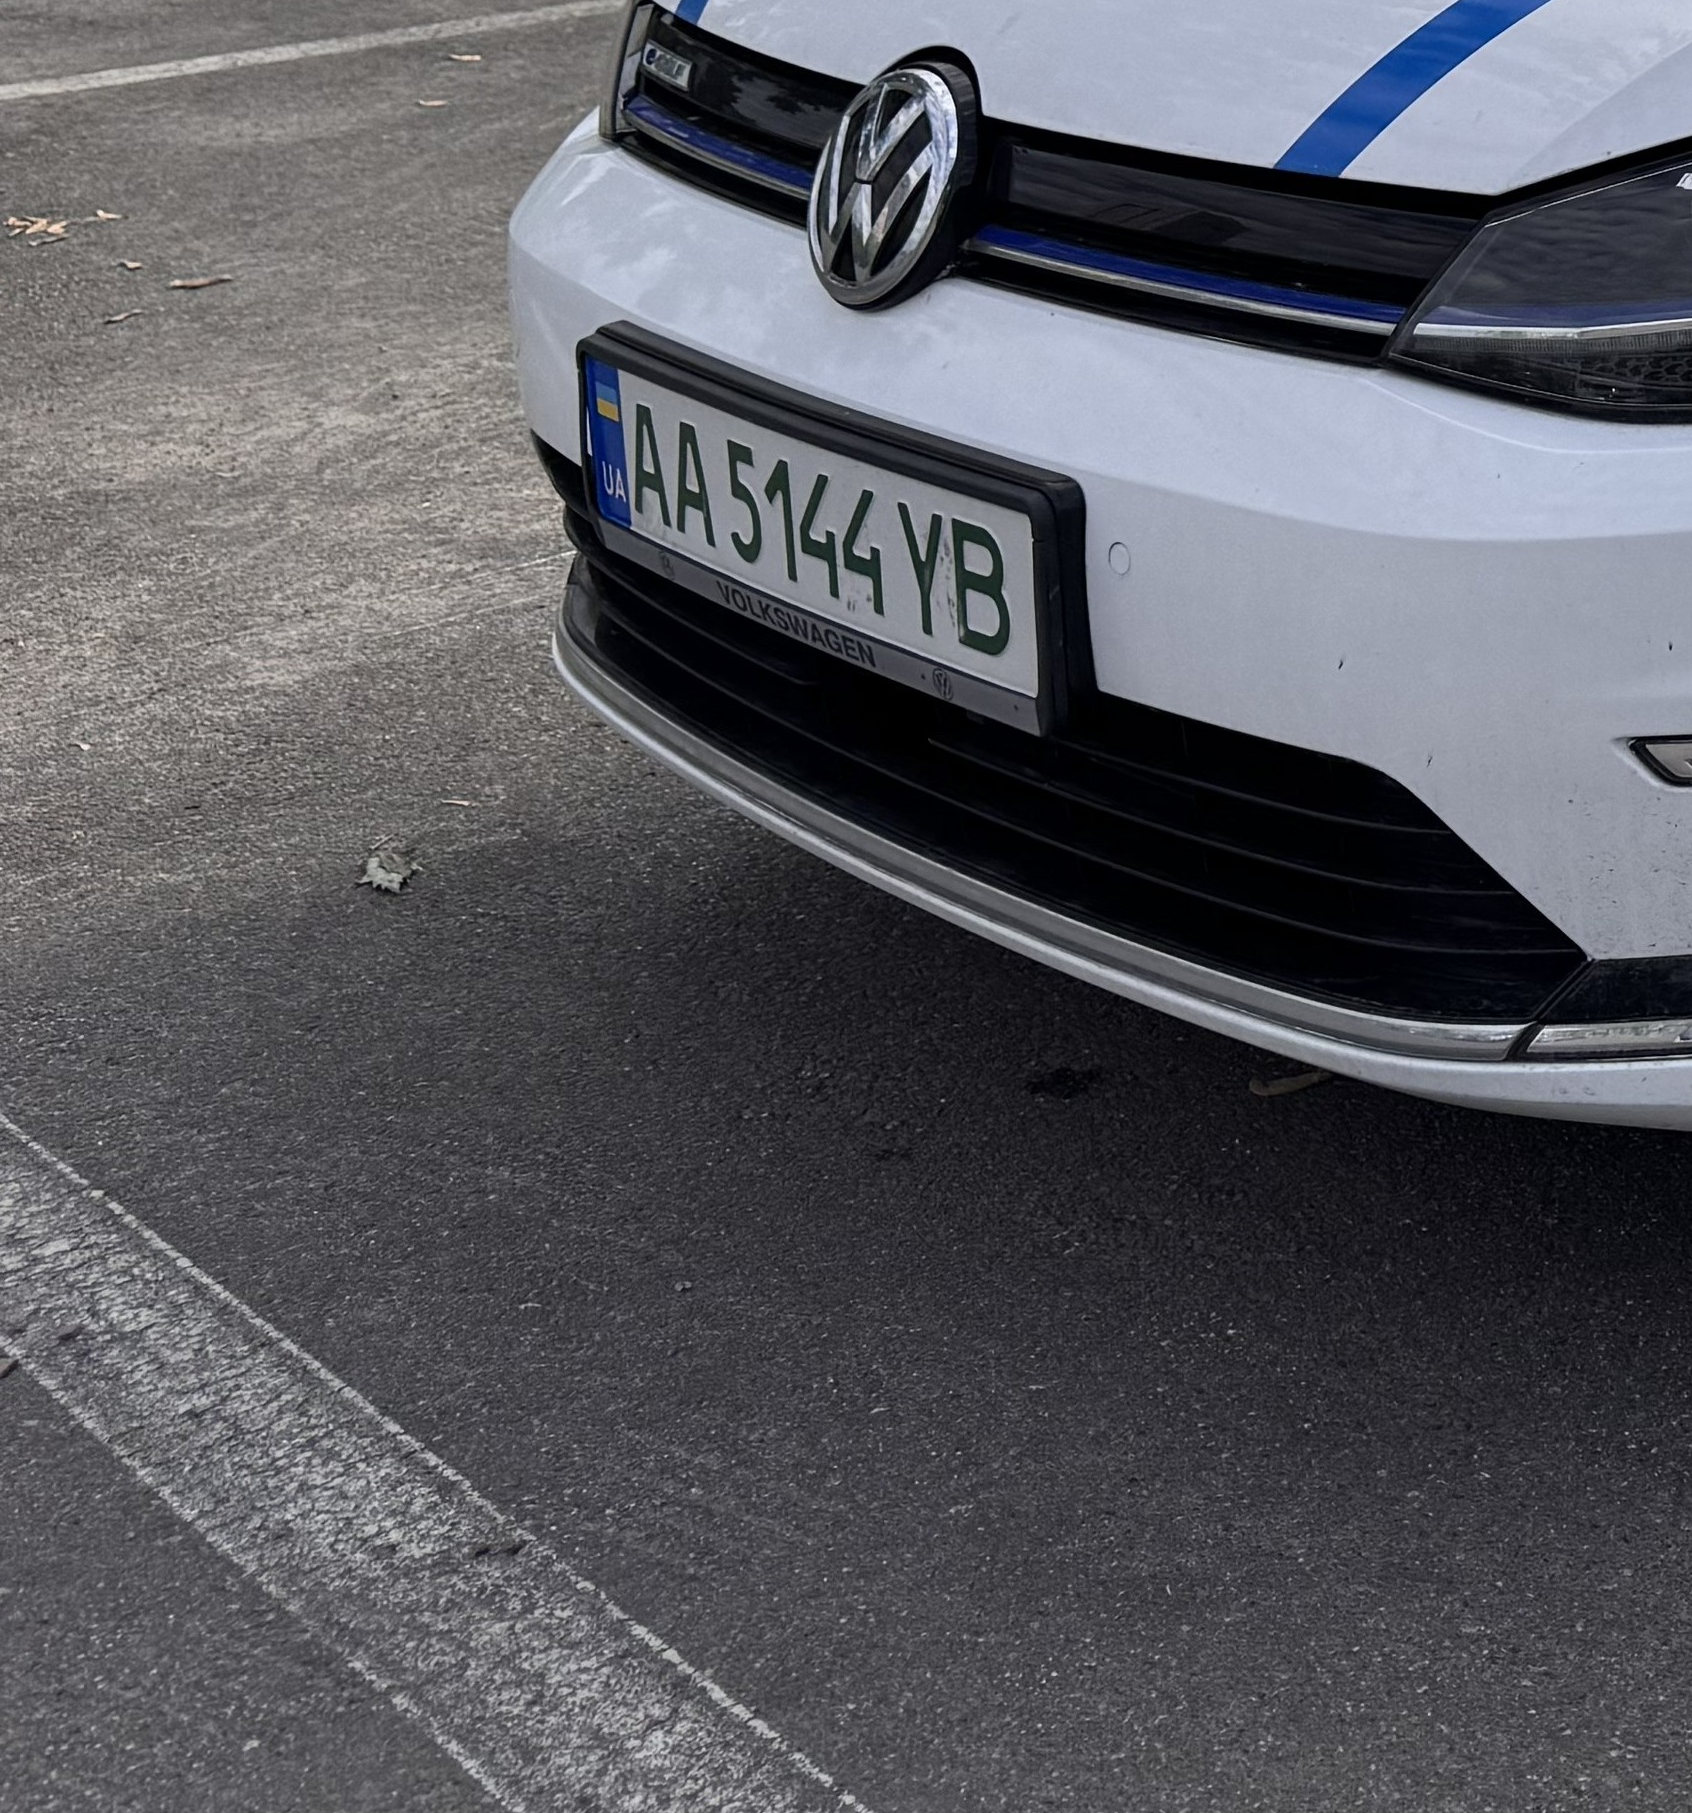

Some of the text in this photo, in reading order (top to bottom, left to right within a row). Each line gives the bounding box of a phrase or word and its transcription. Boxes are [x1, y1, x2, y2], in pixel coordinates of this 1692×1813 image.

[601, 459, 628, 504] UA
[634, 402, 1011, 656] AA 5144 YB
[715, 580, 877, 669] VOLKSWAGEN
